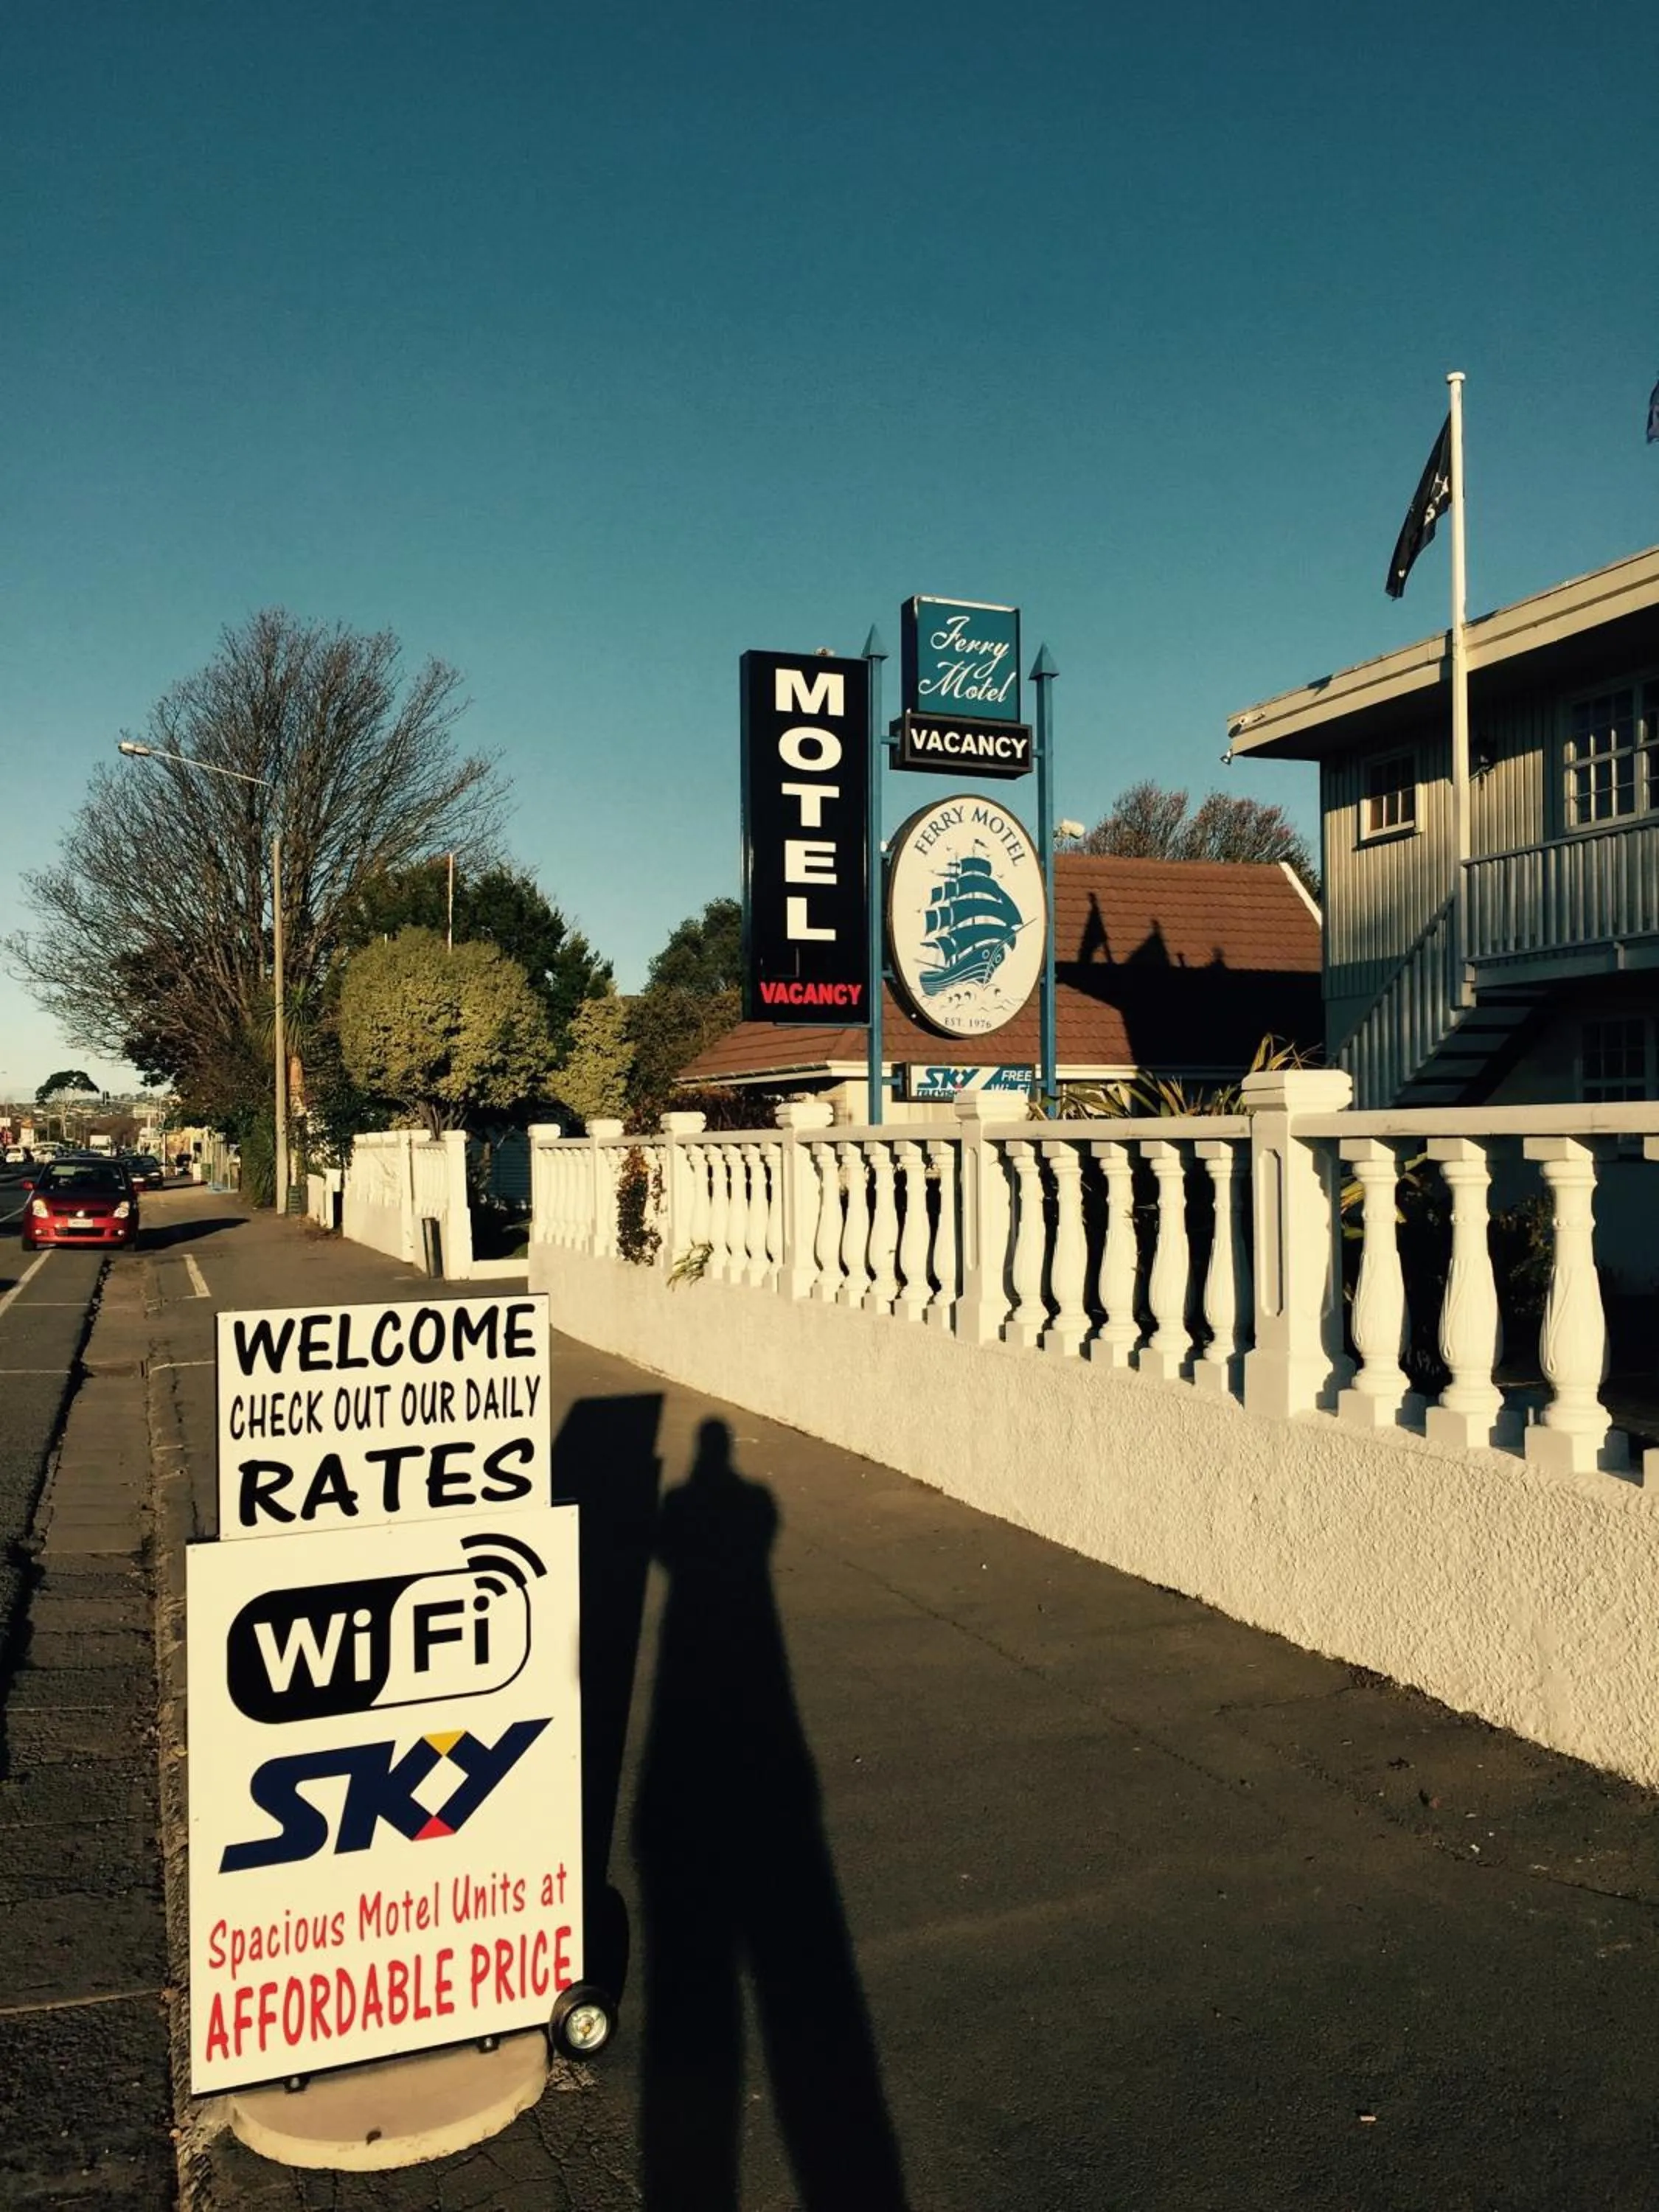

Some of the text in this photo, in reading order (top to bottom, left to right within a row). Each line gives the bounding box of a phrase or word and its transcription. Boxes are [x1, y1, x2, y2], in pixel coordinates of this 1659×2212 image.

[931, 616, 1009, 679] Ferry
[918, 661, 1016, 702] Motel
[911, 728, 1028, 759] VACANCY
[775, 668, 844, 941] MOTEL
[914, 806, 1026, 866] FERRY MOTEL
[760, 981, 861, 1005] VACANCY
[917, 1067, 980, 1090] SKY
[1001, 1070, 1032, 1082] FREE
[234, 1303, 537, 1376] WELCOME
[229, 1375, 541, 1440] CHECK OUT OUR DAILY
[238, 1437, 535, 1526] RATES
[218, 1717, 554, 1874] SKY
[209, 1863, 568, 1980] Spacious Motel Units at
[206, 1926, 573, 2062] AFFORDABLE PRICE
